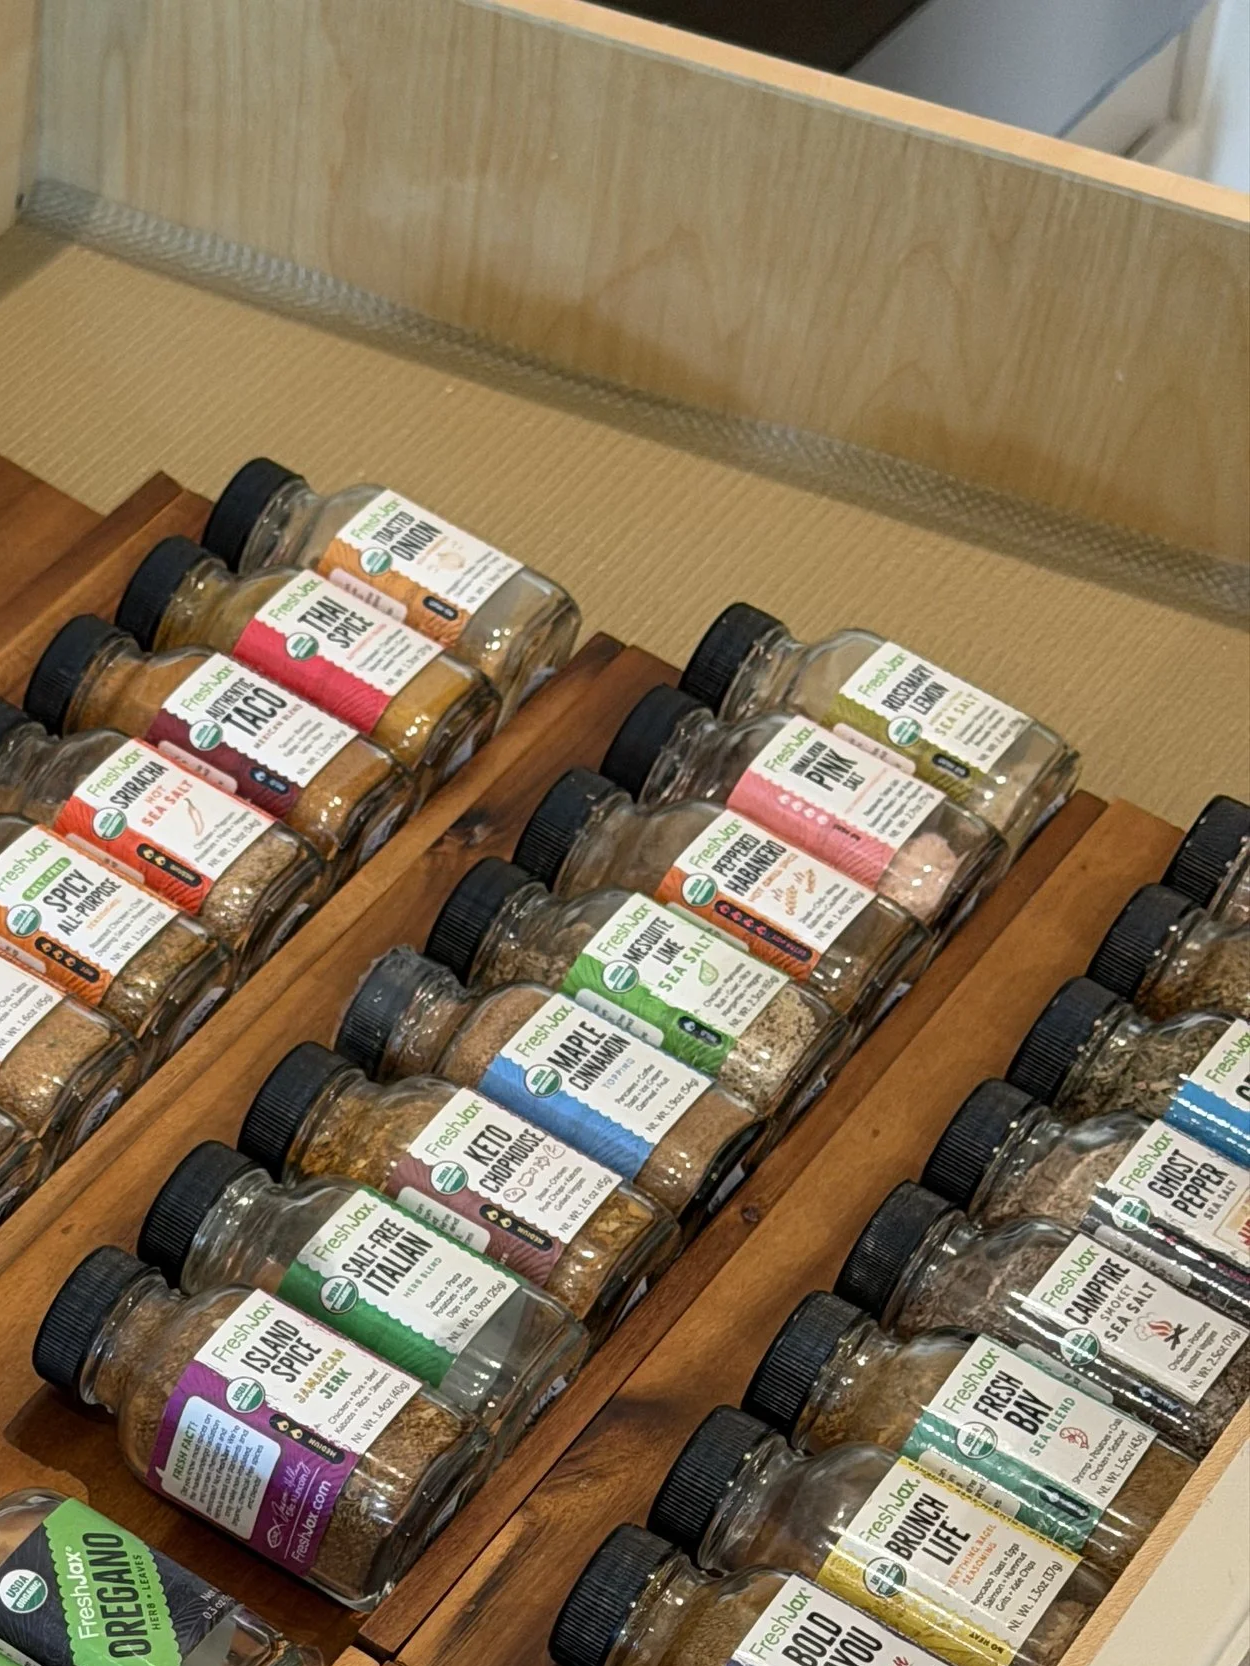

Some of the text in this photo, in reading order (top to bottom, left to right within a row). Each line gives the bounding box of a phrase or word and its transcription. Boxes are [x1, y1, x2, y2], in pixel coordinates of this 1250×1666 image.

[372, 512, 414, 545] TOASTED
[391, 521, 442, 561] ONION
[298, 596, 349, 632] THAI
[327, 612, 374, 649] SPICE
[206, 677, 255, 720] AUTHENTIC
[221, 687, 287, 736] TACO
[882, 664, 935, 712] ROSEMARY
[908, 682, 949, 716] LEMON
[110, 761, 169, 809] SRIRACHA
[170, 779, 193, 804] SALT
[805, 748, 857, 791] PINK
[712, 834, 761, 878] PEPPERED
[724, 840, 787, 896] HABANERO
[43, 869, 94, 913] SPICY
[58, 878, 122, 936] ALL-PURPOSE
[623, 916, 674, 964] MESQUITE
[652, 938, 684, 966] LIME
[658, 934, 713, 992] SEA SALT
[547, 1021, 606, 1073] MAPLE
[569, 1034, 631, 1091] CINNAMON
[464, 1124, 512, 1167] KETO
[1119, 1132, 1173, 1191] FreshJax
[1148, 1149, 1198, 1199] GHOST
[1171, 1163, 1229, 1219] PEPPER
[1204, 1180, 1237, 1220] SEA SALT
[342, 1218, 405, 1278] SALT-FREE
[517, 1225, 545, 1245] MEDIUM
[363, 1231, 433, 1297] ITALIAN
[403, 1279, 423, 1298] HERB
[1065, 1258, 1130, 1325] CAMPFIRE
[1100, 1285, 1134, 1322] SMOKEY
[1104, 1282, 1157, 1342] SEA SALT
[212, 1300, 274, 1362] FreshJax
[240, 1320, 300, 1374] ISLAND
[271, 1337, 323, 1383] SPICE
[293, 1349, 346, 1404] JAMAICAN
[943, 1348, 1000, 1413] FreshJax
[318, 1369, 353, 1400] JERK
[973, 1370, 1023, 1421] FRESH
[1003, 1390, 1054, 1436] BAY
[173, 1420, 199, 1480] FRESH FACT!
[308, 1439, 337, 1458] MEDIUM
[1029, 1432, 1052, 1457] SEA
[291, 1481, 332, 1563] FreshJax.com
[884, 1493, 949, 1561] BRUNCH
[921, 1523, 971, 1566] LIFE
[976, 1524, 996, 1550] BAGEL
[962, 1543, 997, 1585] SEASONING
[65, 1545, 99, 1640] FreshJax
[83, 1532, 152, 1660] OREGANO
[132, 1554, 160, 1631] HERB LEAVES
[749, 1587, 813, 1661] FreshJax
